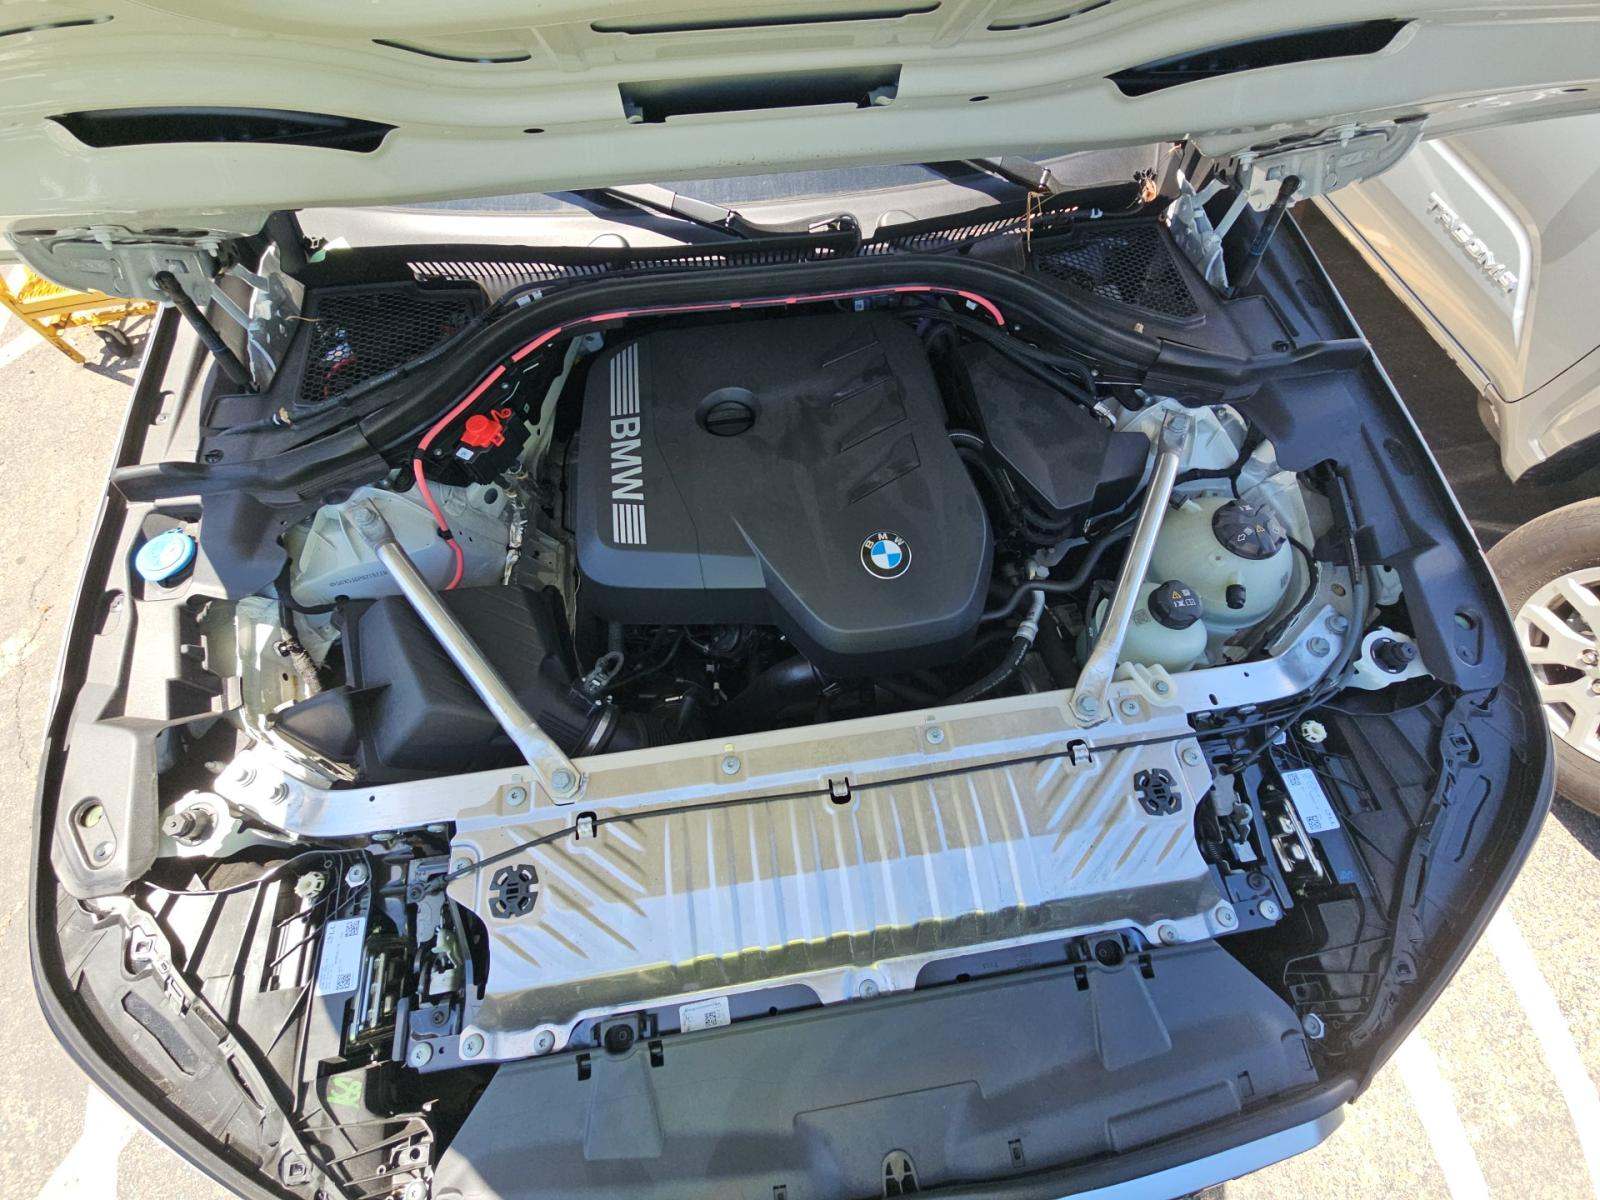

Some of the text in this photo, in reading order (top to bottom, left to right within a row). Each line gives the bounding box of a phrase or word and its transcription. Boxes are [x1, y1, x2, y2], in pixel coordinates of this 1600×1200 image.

[1429, 191, 1518, 294] TACOMA
[610, 416, 645, 500] BMW
[864, 532, 905, 550] BMW
